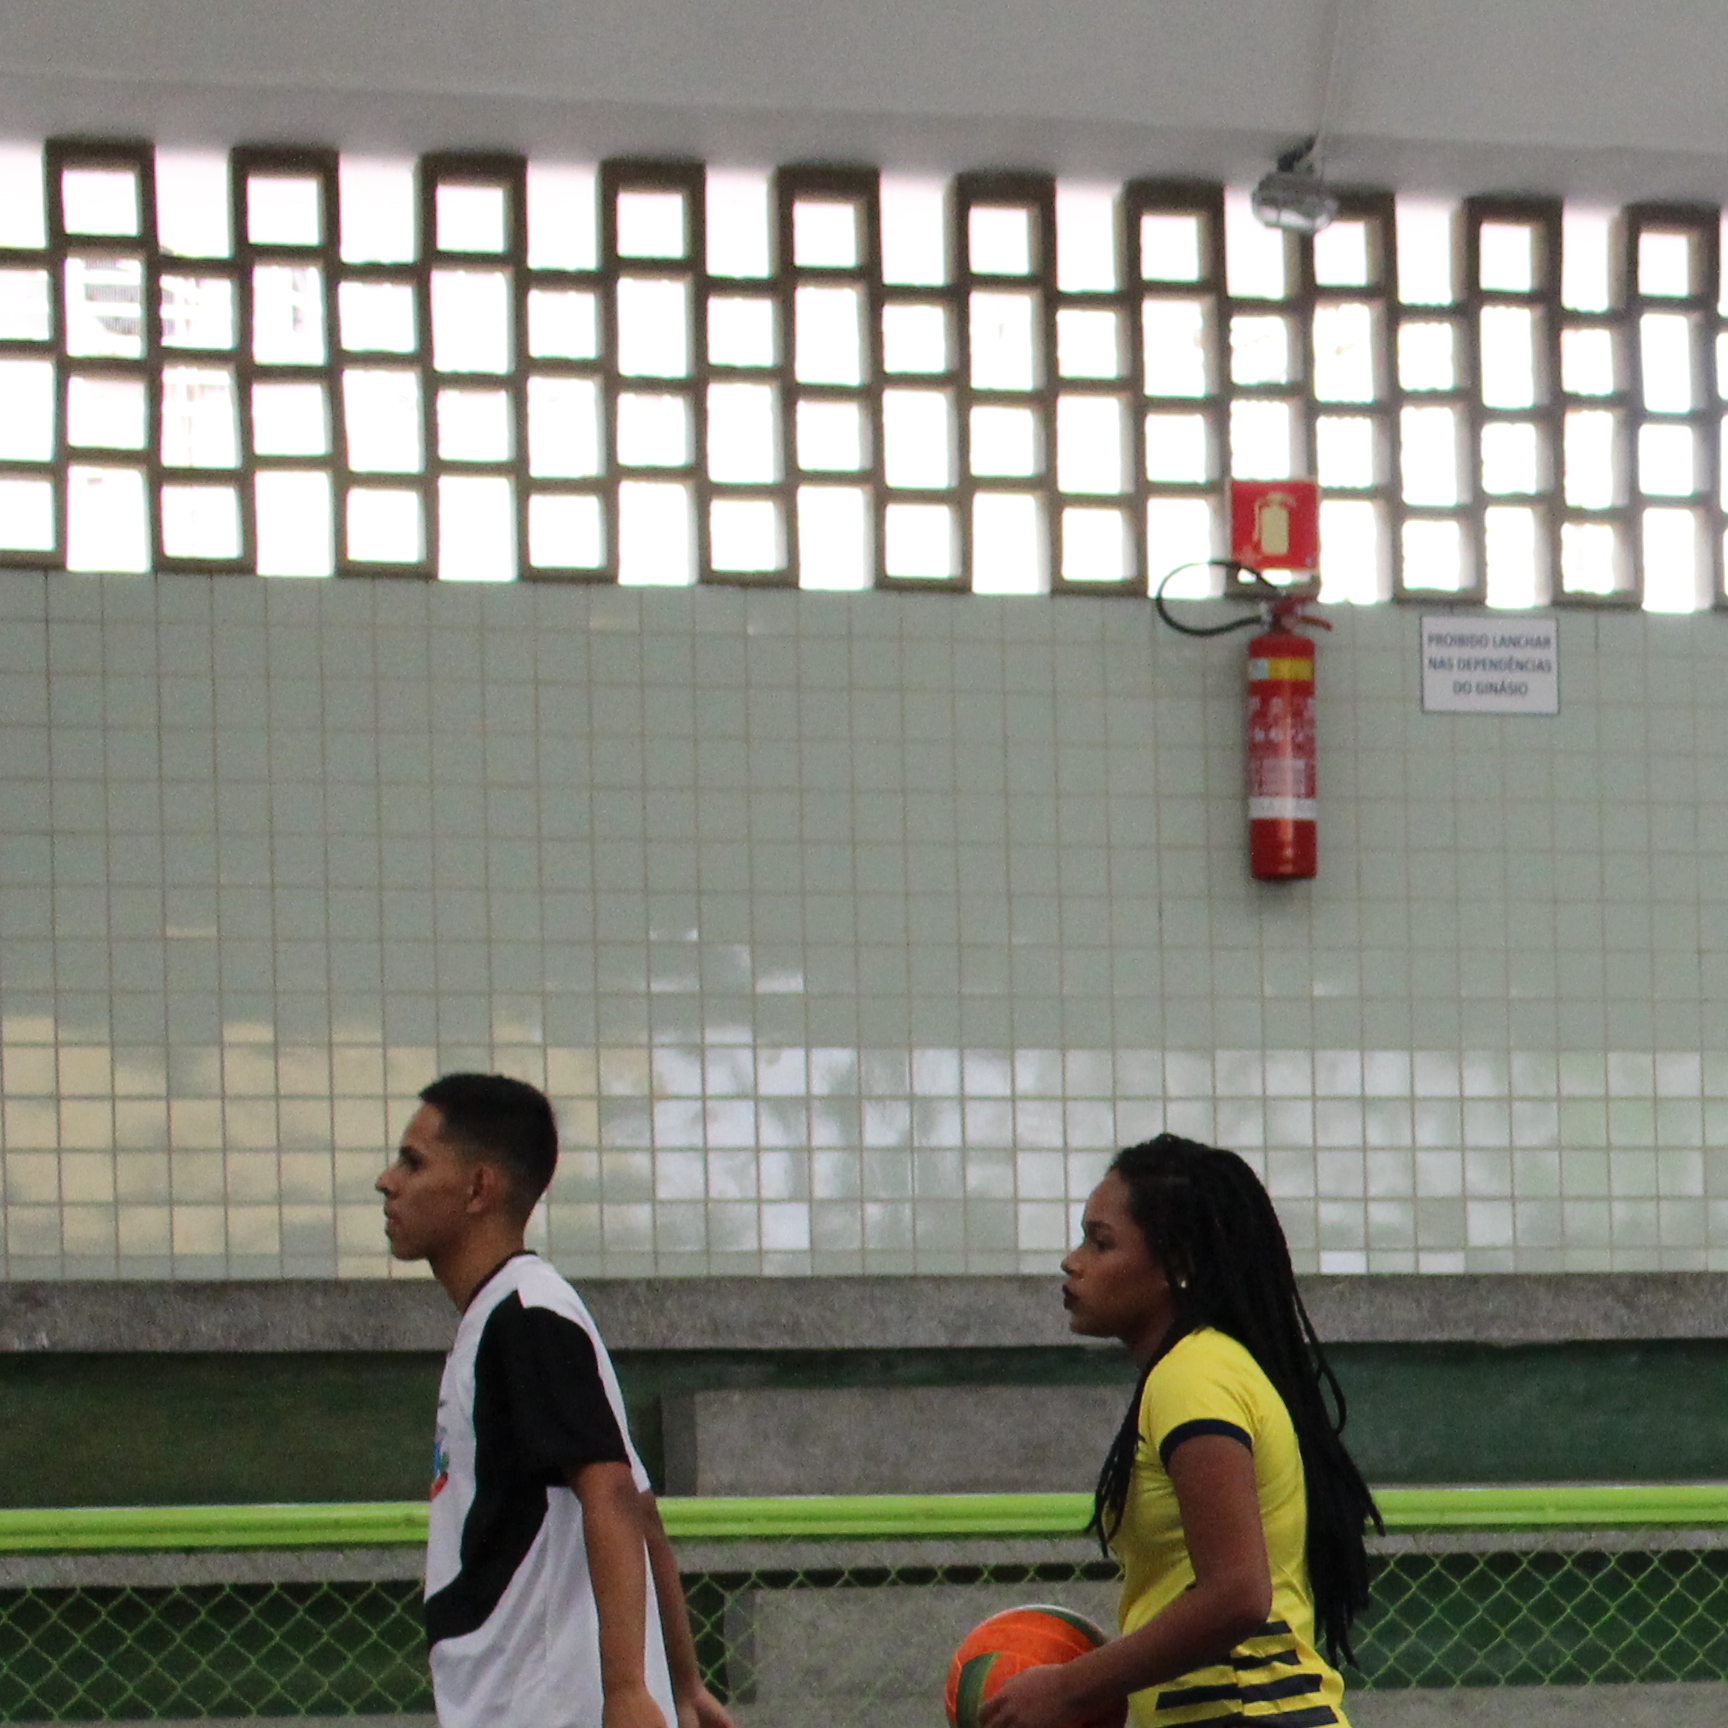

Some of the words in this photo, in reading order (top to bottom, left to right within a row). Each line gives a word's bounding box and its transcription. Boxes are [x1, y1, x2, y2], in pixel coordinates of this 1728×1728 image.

[1427, 633, 1489, 648] PROIBIDO
[1492, 634, 1551, 649] LANCHAR
[1428, 657, 1454, 671] NAS
[1457, 655, 1551, 673] DEPENDÊNCIAS
[1453, 681, 1472, 695] DO
[1476, 680, 1528, 697] GINÁSIO
